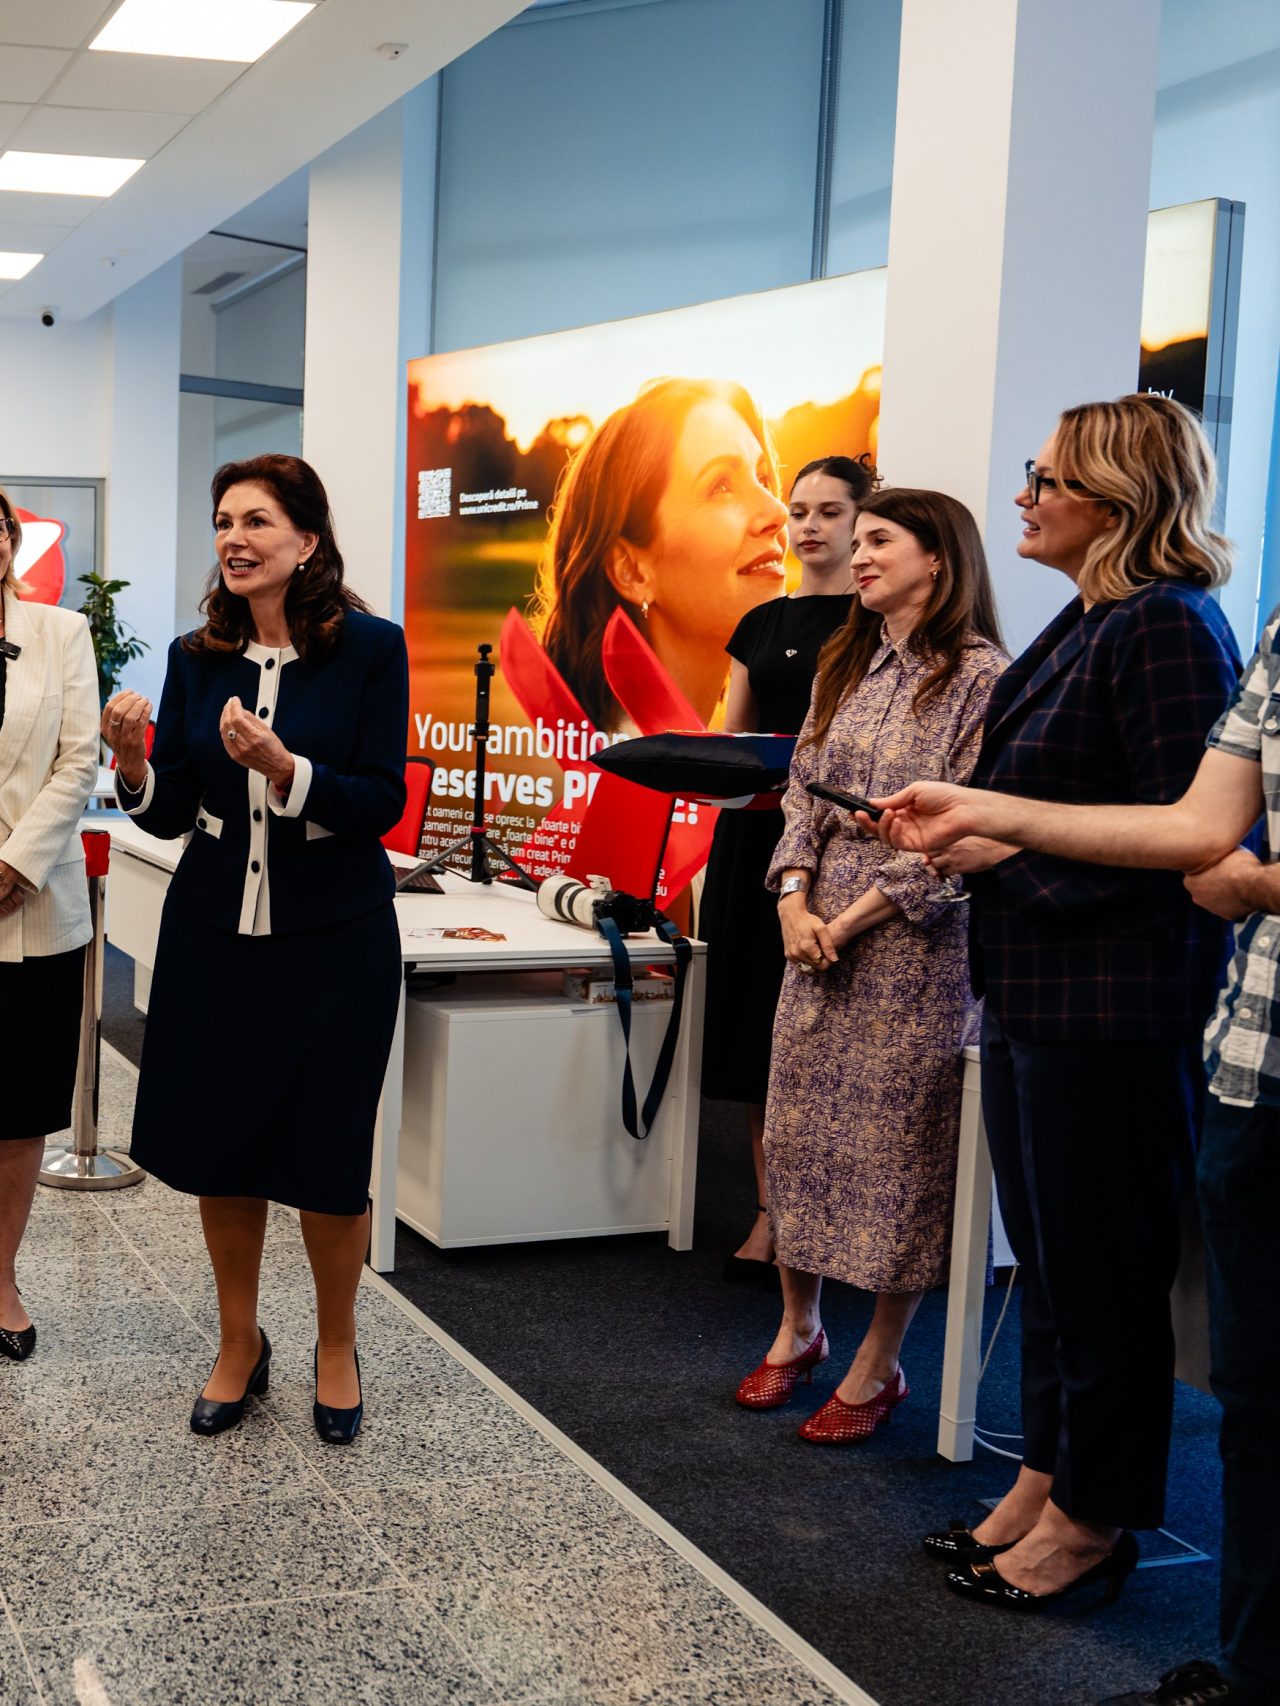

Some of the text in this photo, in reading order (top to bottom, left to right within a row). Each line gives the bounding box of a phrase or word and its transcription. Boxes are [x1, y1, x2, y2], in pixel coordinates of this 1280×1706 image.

[517, 488, 527, 499] pe
[431, 767, 553, 807] eserves
[432, 807, 463, 819] oameni
[484, 813, 494, 824] se
[495, 814, 524, 828] opresc
[526, 816, 535, 829] la
[509, 846, 525, 858] am
[526, 848, 550, 862] creat
